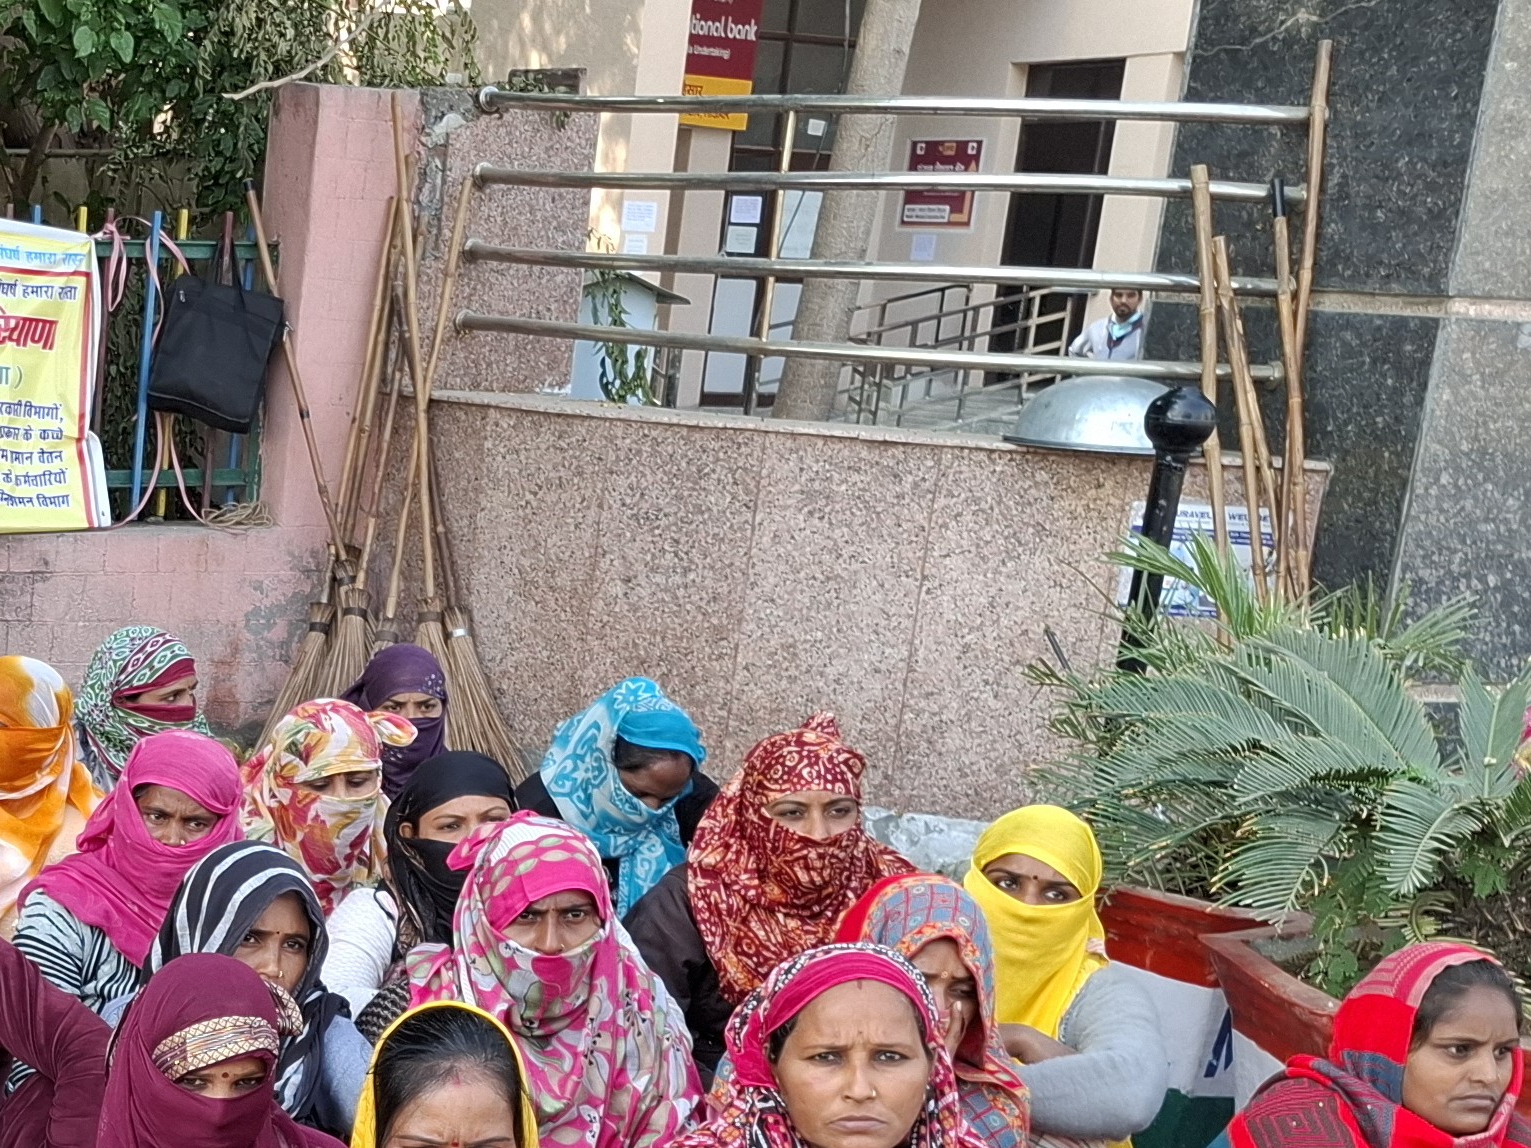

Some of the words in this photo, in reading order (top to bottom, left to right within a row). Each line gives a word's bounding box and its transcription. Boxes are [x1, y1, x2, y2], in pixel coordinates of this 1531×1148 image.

[727, 16, 757, 41] bank
[24, 251, 57, 265] हमारा
[22, 285, 55, 299] हमारा
